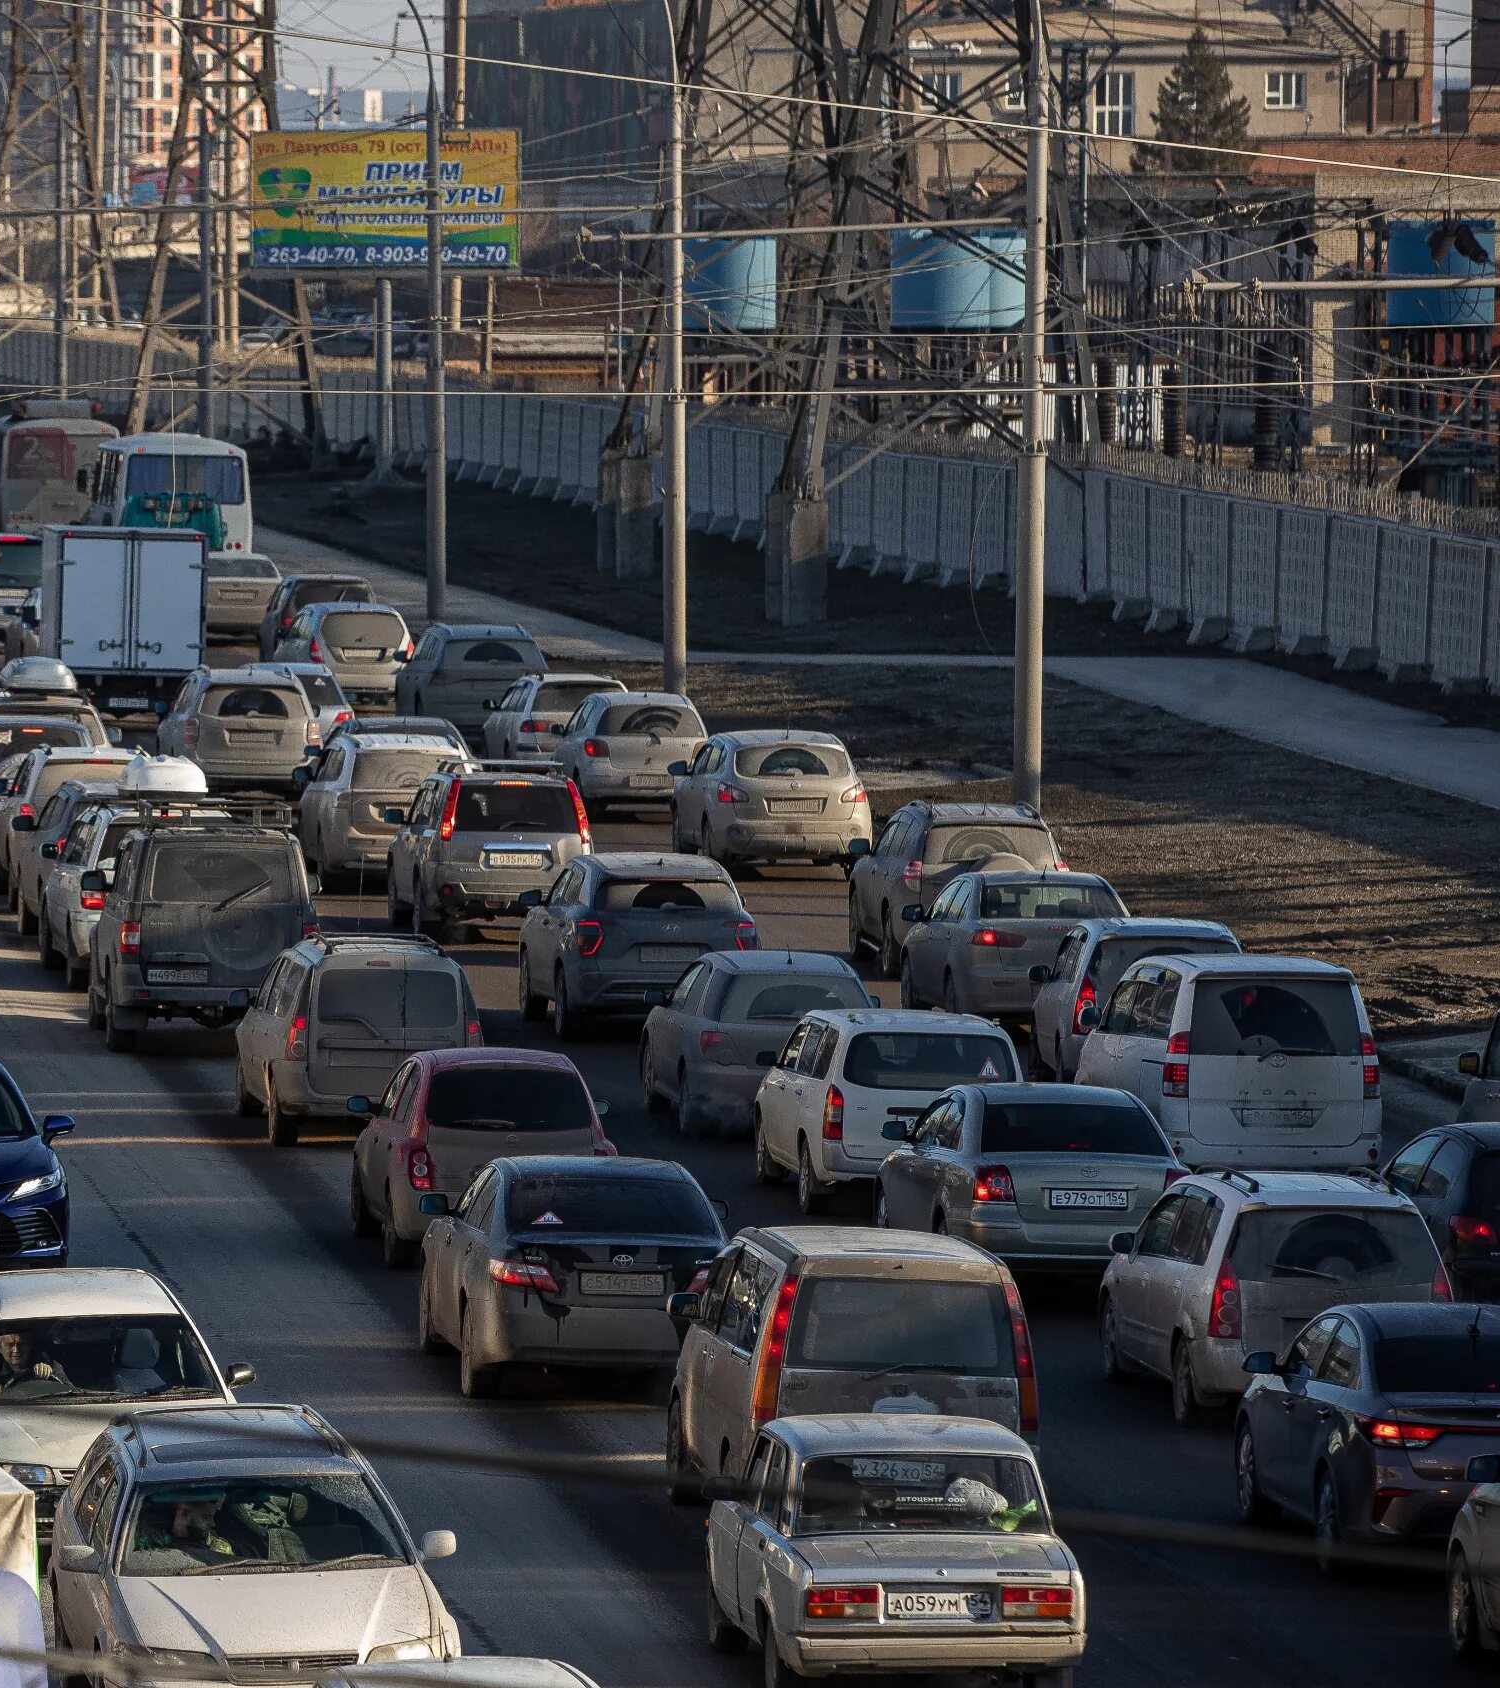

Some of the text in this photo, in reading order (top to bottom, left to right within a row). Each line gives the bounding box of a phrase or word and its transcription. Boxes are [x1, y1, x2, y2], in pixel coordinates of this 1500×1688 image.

[368, 139, 385, 152] 79
[316, 184, 504, 206] МАКУЛАУРЫ
[366, 245, 507, 262] 8-903-90-40-70
